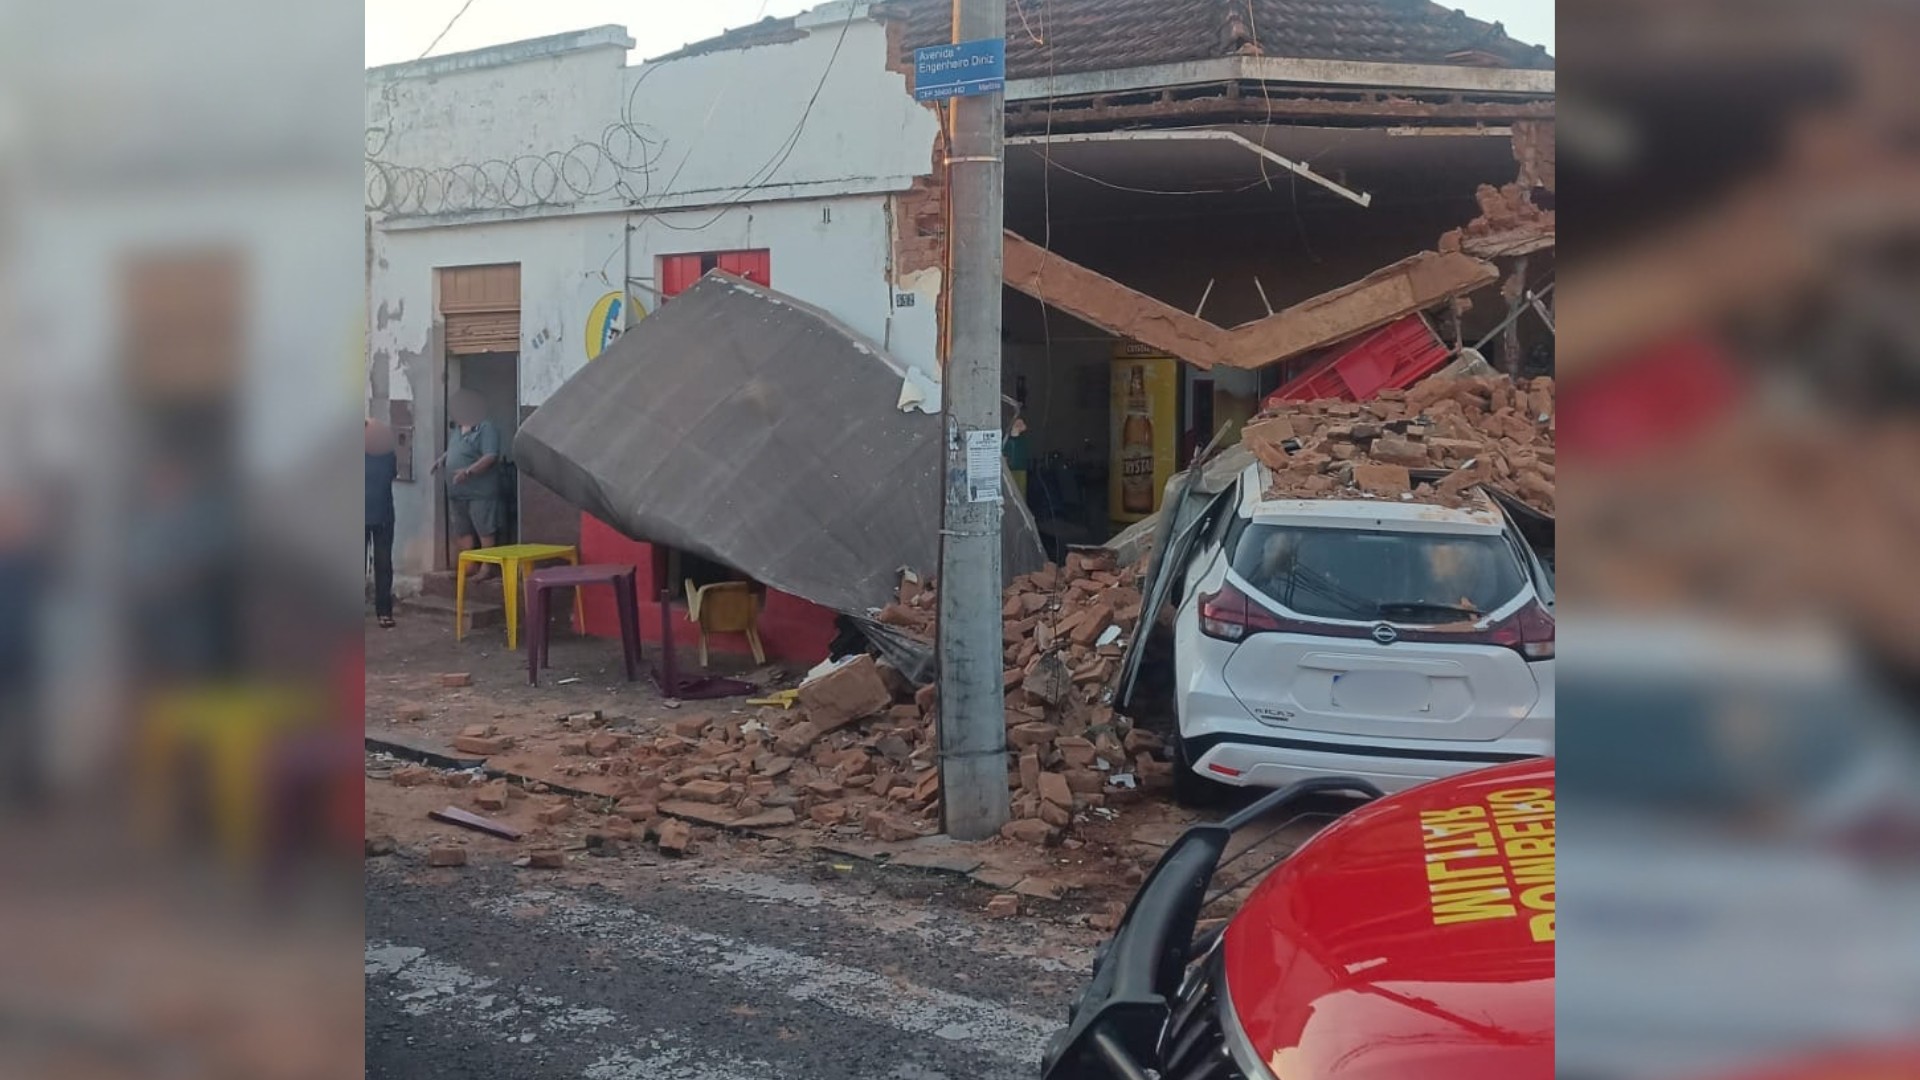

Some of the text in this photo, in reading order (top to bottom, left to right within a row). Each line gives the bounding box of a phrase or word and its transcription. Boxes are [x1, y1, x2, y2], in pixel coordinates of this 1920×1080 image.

[919, 49, 955, 61] Avenida
[919, 54, 995, 74] Engenheiro Diniz
